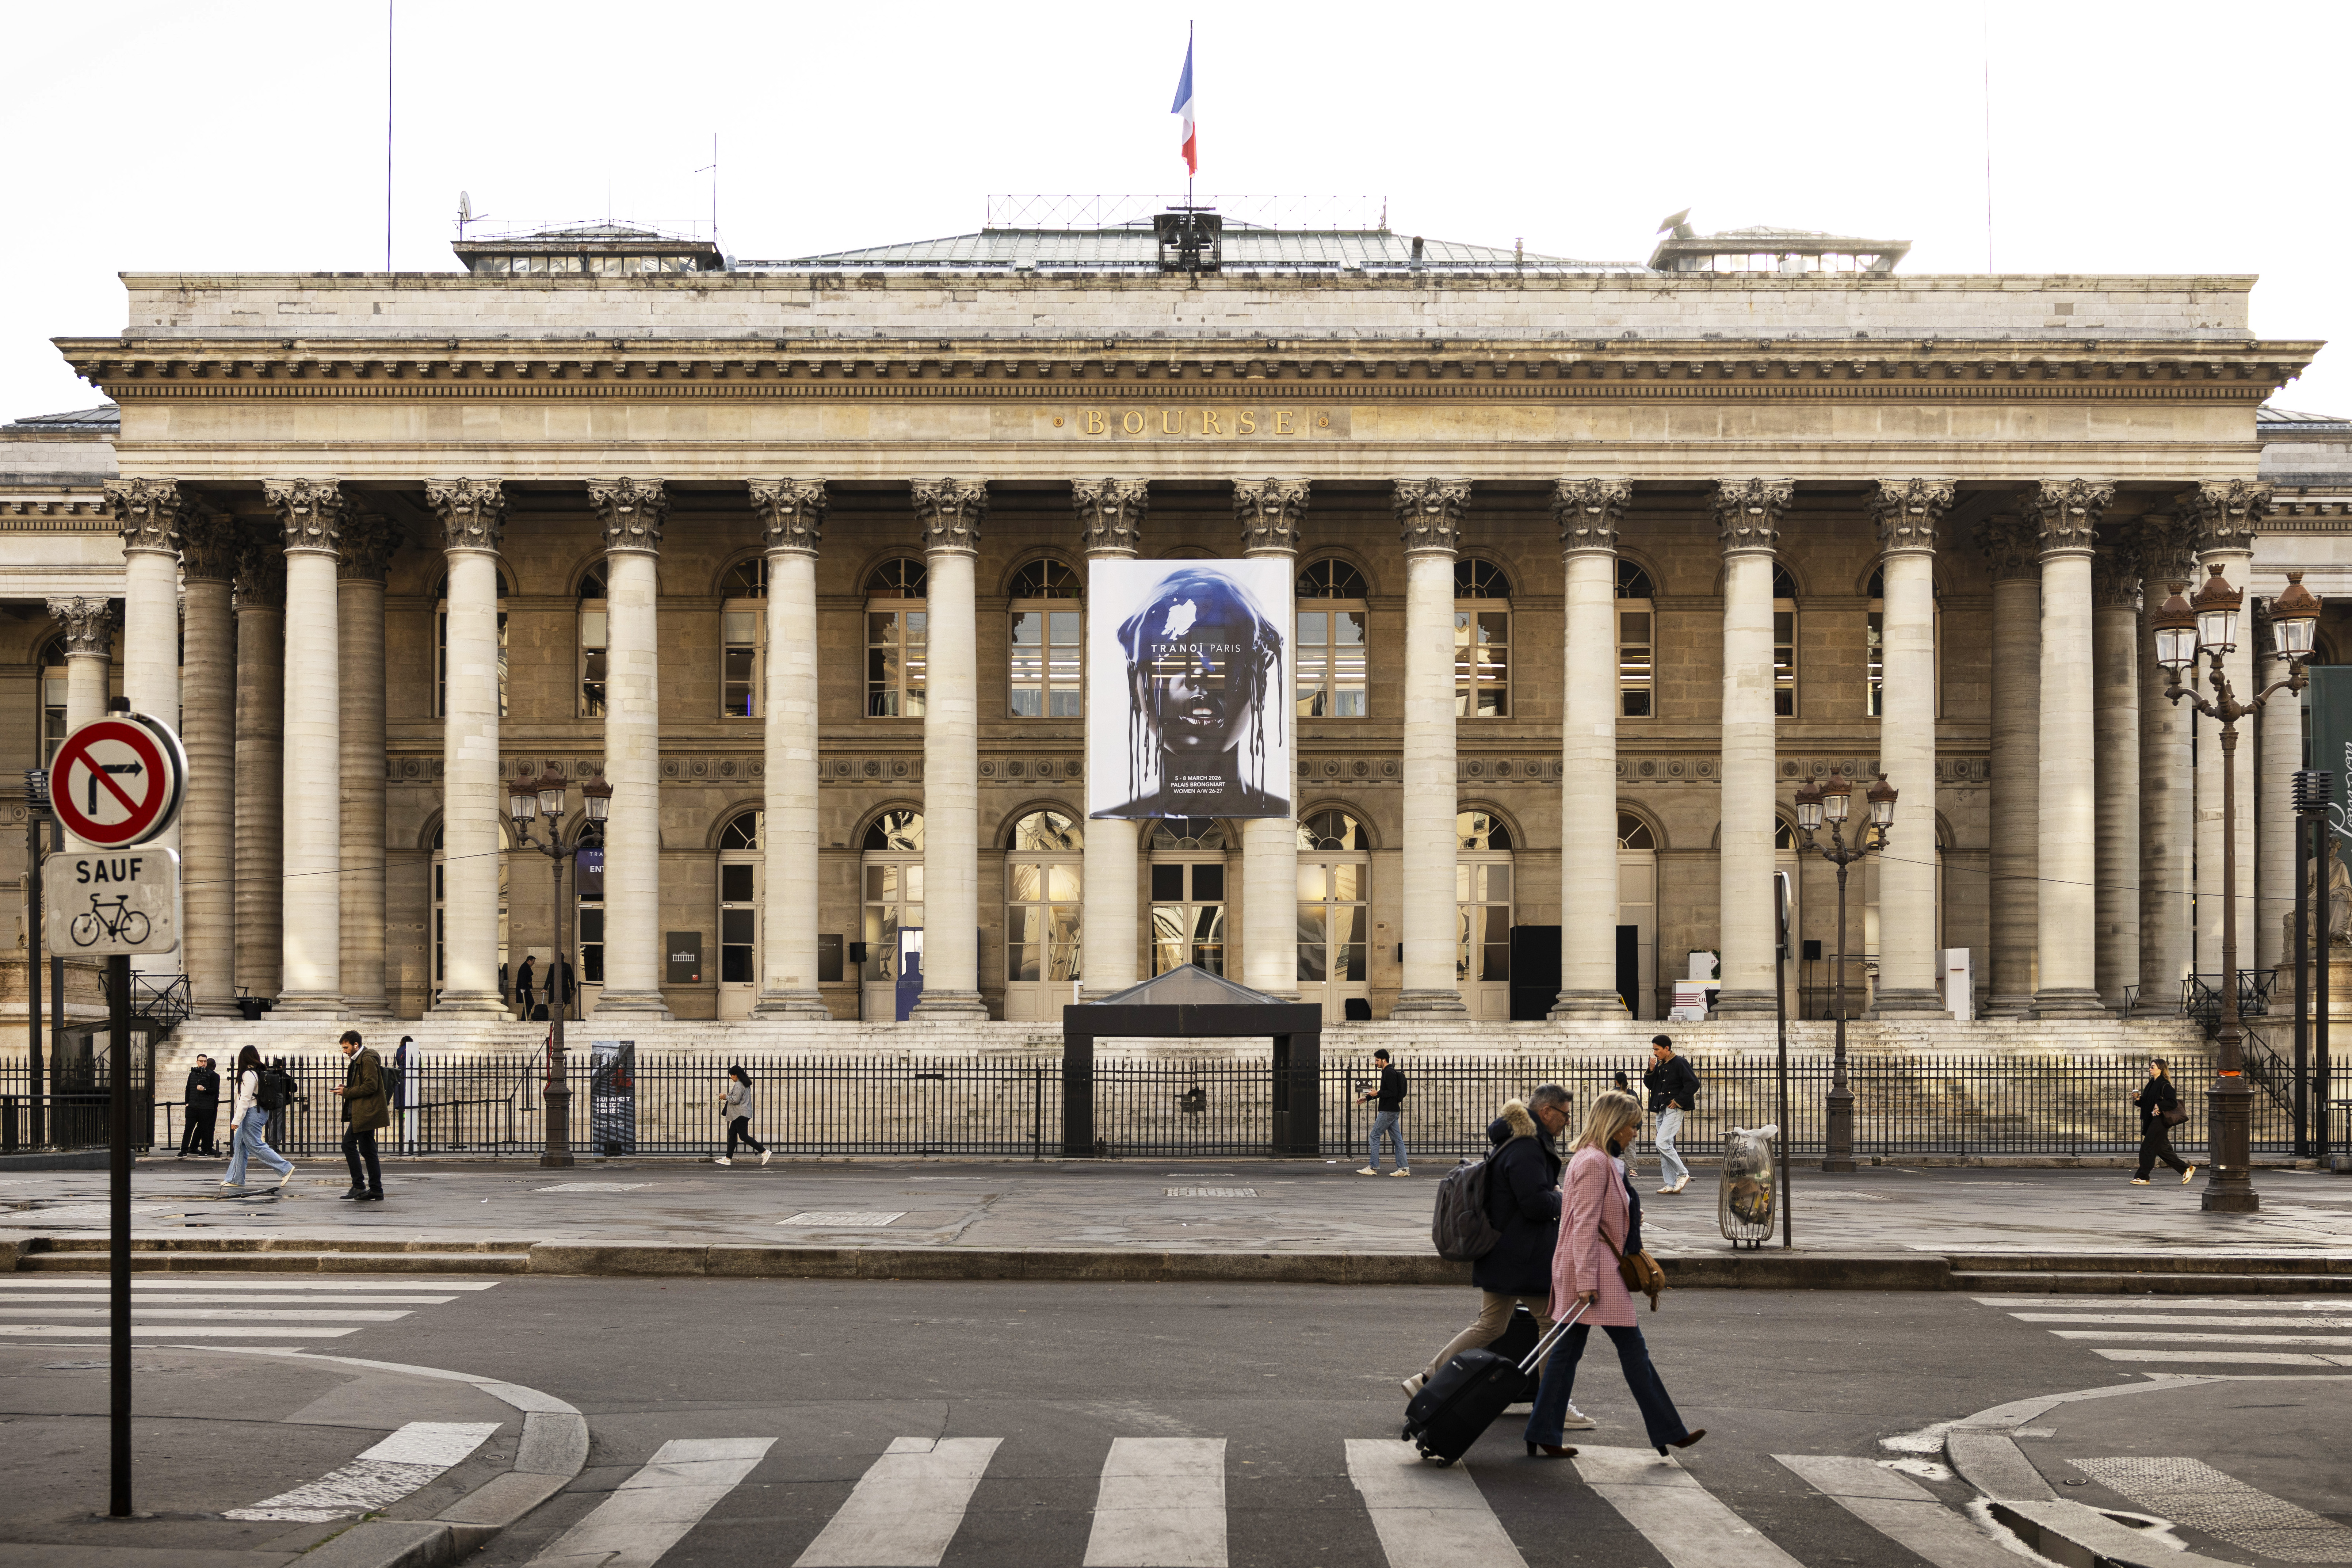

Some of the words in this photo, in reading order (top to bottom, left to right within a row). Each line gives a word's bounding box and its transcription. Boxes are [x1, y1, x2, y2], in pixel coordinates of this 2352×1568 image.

[1086, 411, 1294, 434] BOURSE
[1151, 642, 1203, 652] TRANOÏ
[1210, 644, 1240, 652] PARIS
[77, 858, 142, 884] SAUF
